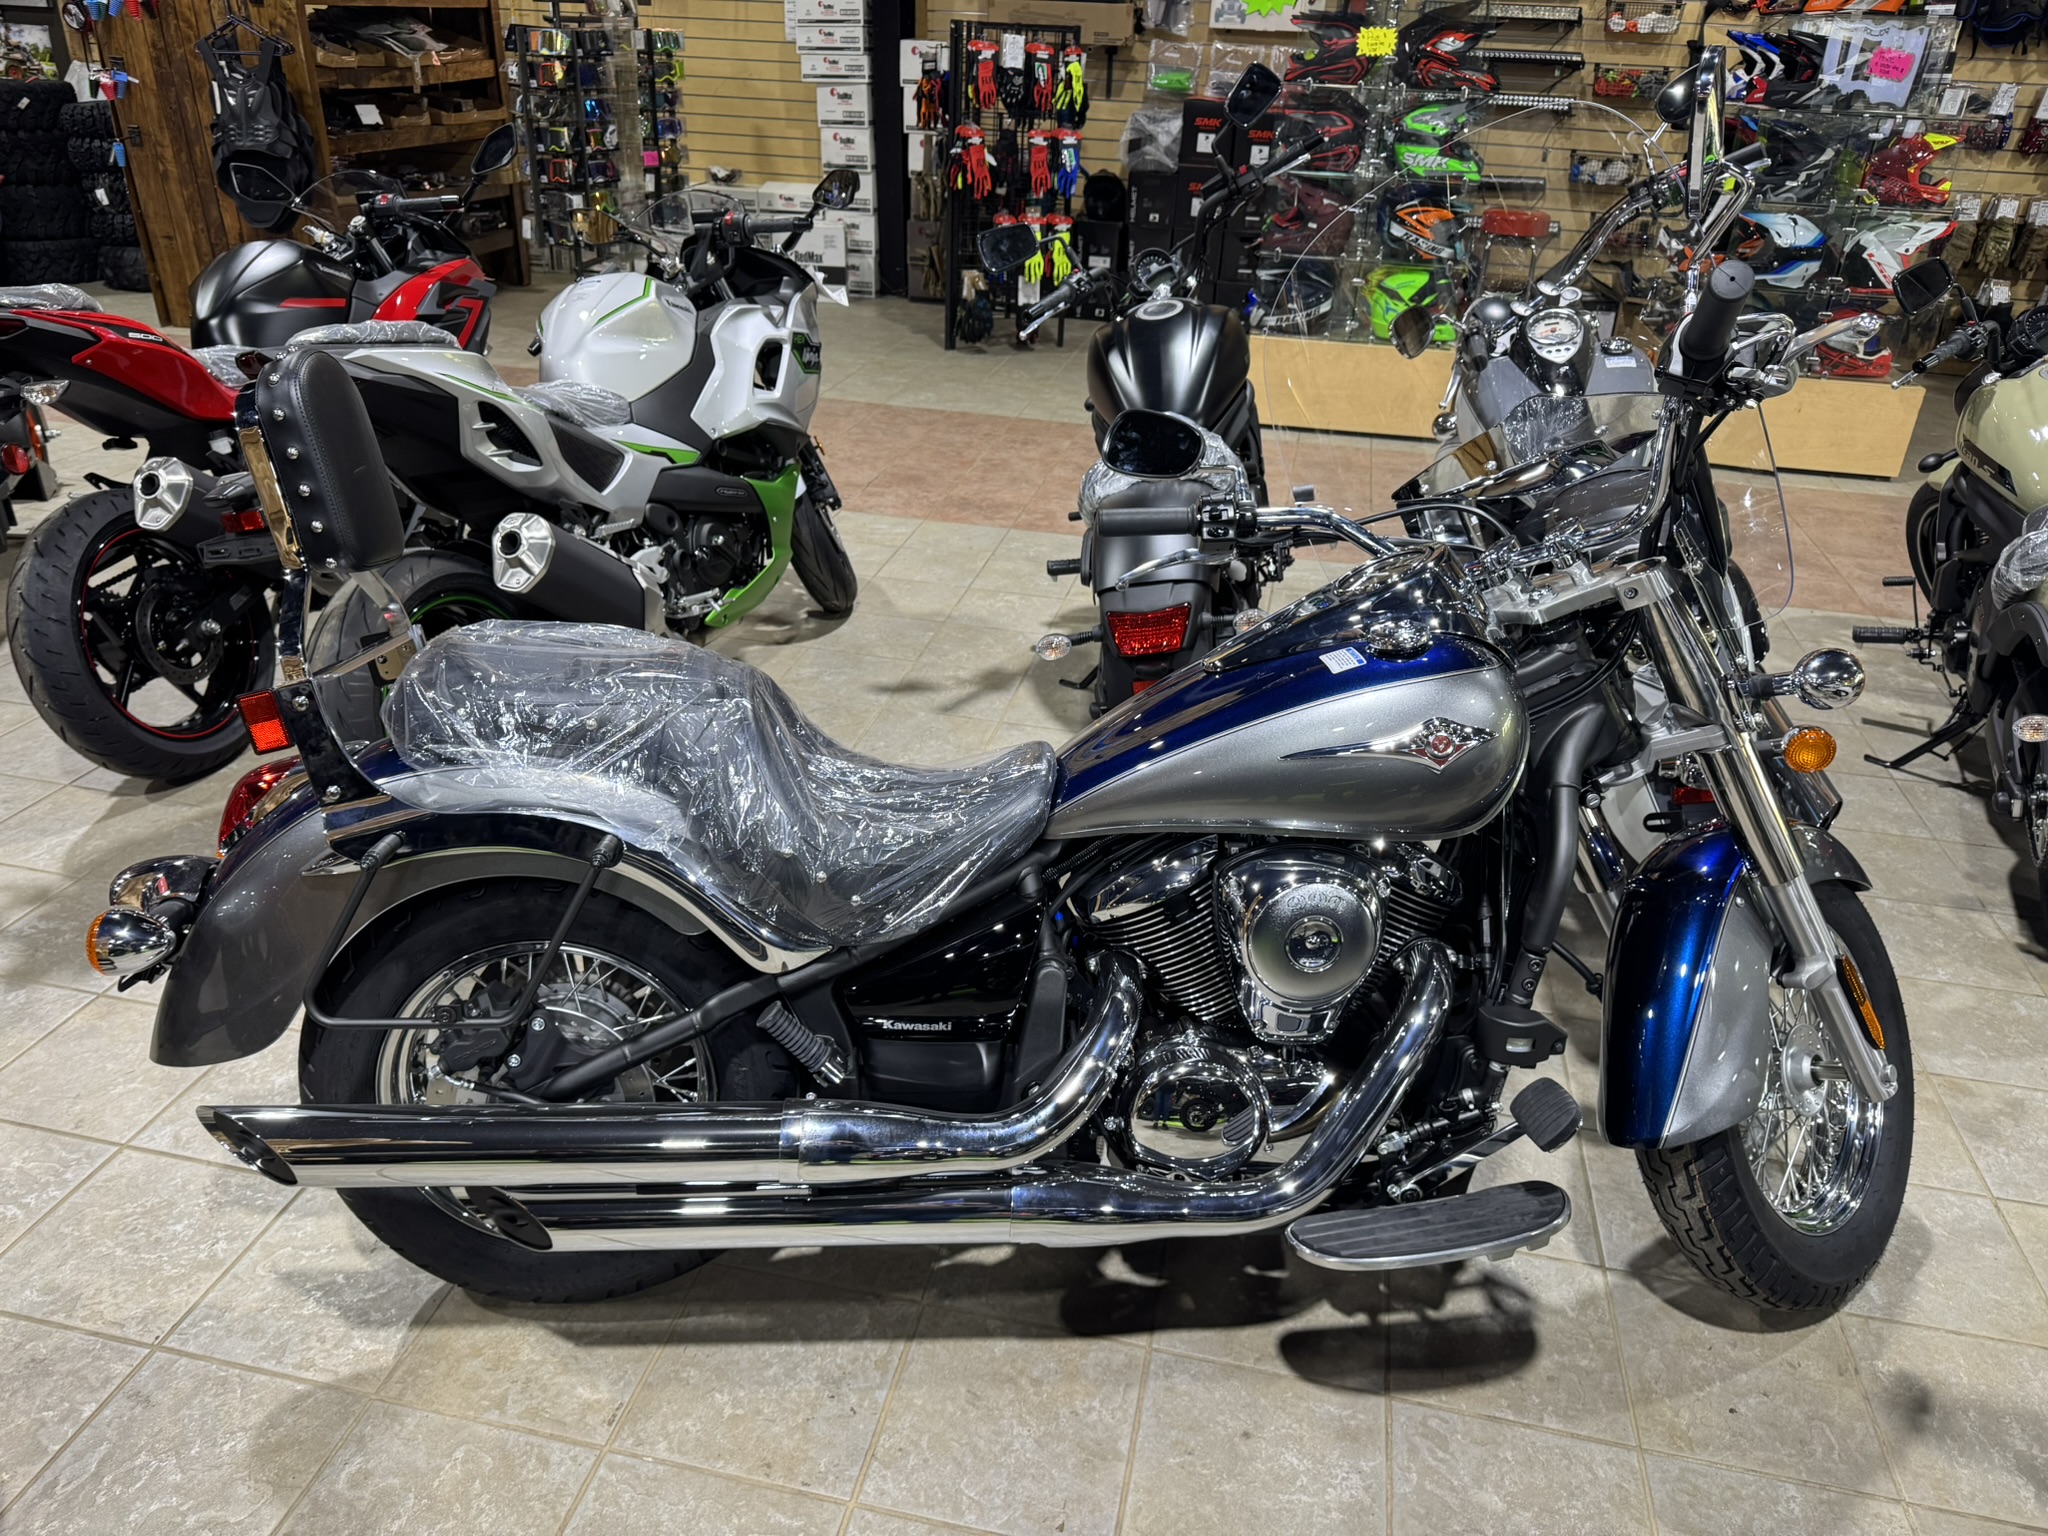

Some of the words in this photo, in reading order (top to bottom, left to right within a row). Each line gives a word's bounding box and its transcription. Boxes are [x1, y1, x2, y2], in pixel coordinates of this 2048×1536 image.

[1193, 117, 1223, 127] SMK
[1247, 130, 1276, 139] SMK
[1402, 152, 1451, 170] SMK
[1400, 231, 1445, 255] RACING
[794, 250, 824, 263] RedMax
[128, 332, 163, 342] 500
[882, 1019, 953, 1031] Kawasaki
